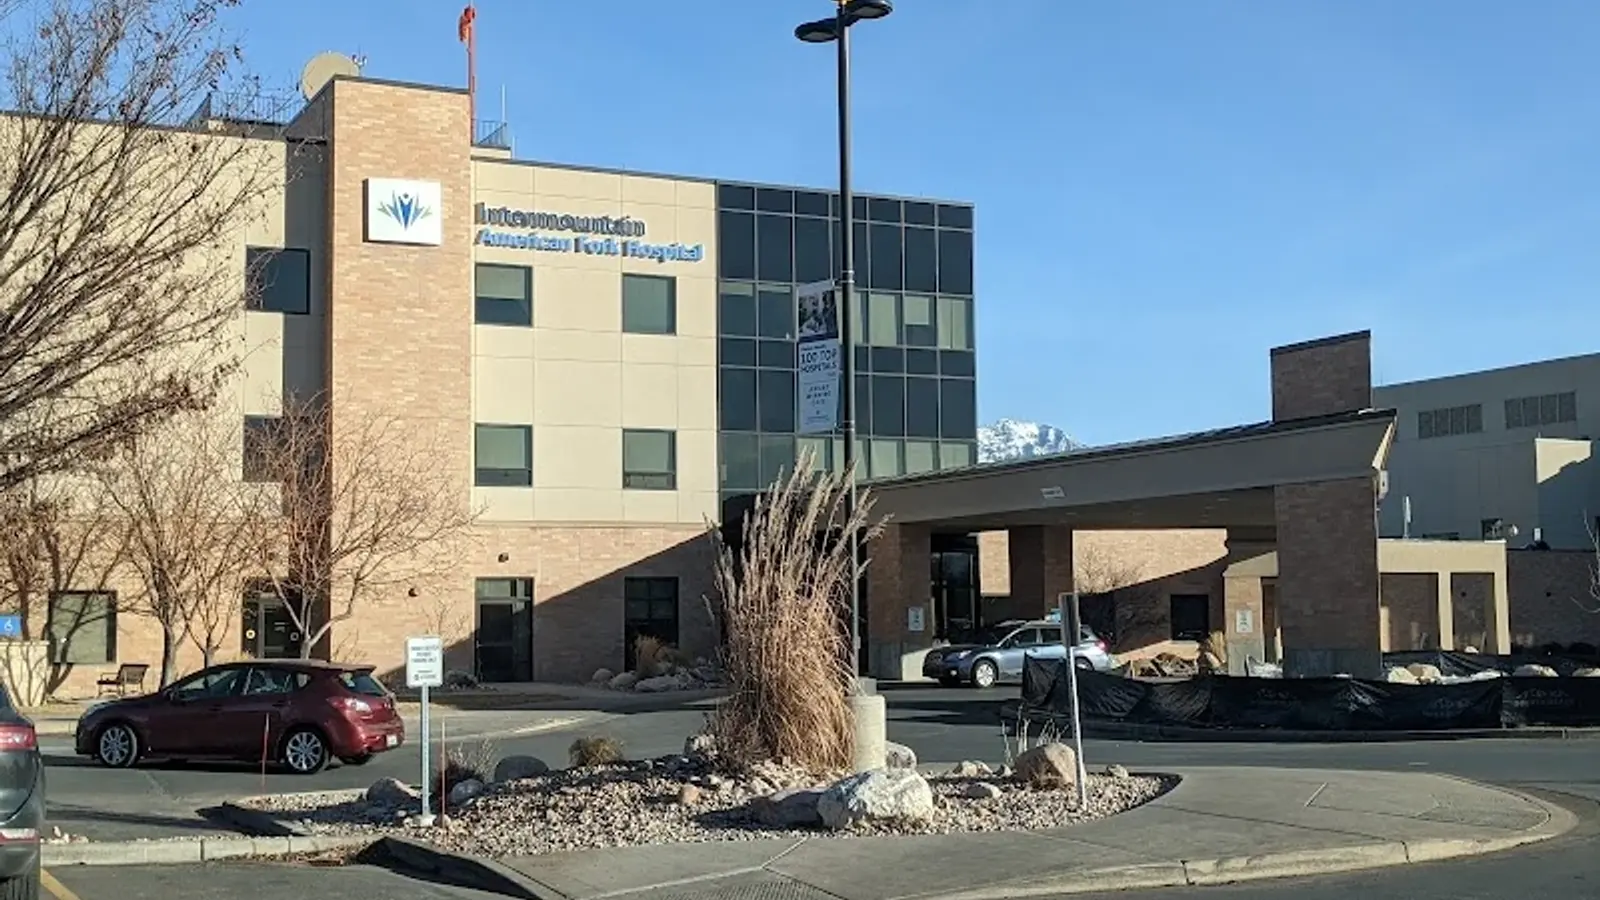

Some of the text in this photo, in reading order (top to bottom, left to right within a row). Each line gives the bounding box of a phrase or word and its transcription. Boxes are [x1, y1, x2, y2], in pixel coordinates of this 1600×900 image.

[474, 202, 646, 236] Intermountain
[474, 229, 705, 263] American Fork Hospital
